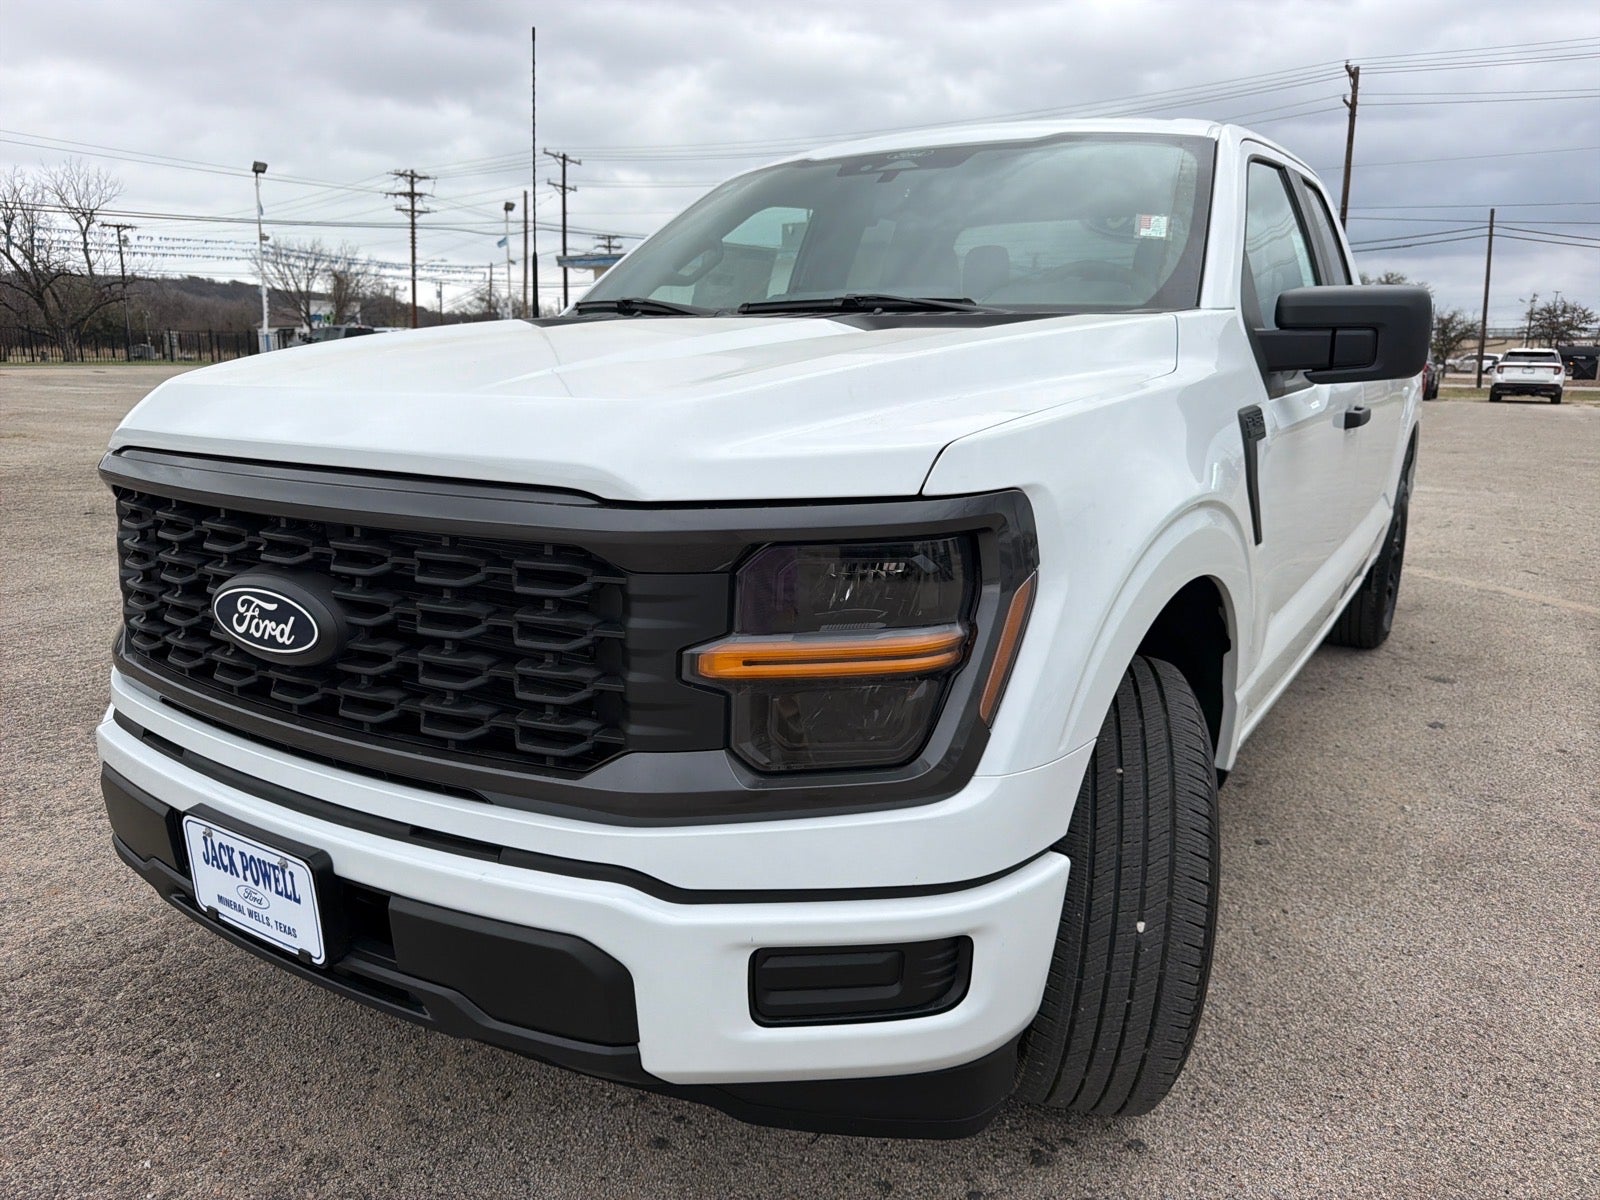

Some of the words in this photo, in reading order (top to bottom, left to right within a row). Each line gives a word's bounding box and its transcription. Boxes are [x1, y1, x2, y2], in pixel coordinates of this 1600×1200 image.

[232, 595, 295, 645] Ford
[203, 836, 240, 878] JACK
[239, 851, 301, 905] POWELL
[217, 894, 246, 916] MINERAL
[247, 908, 273, 930] WELLS,
[274, 920, 297, 938] TEXAS
[243, 888, 263, 905] Ford
